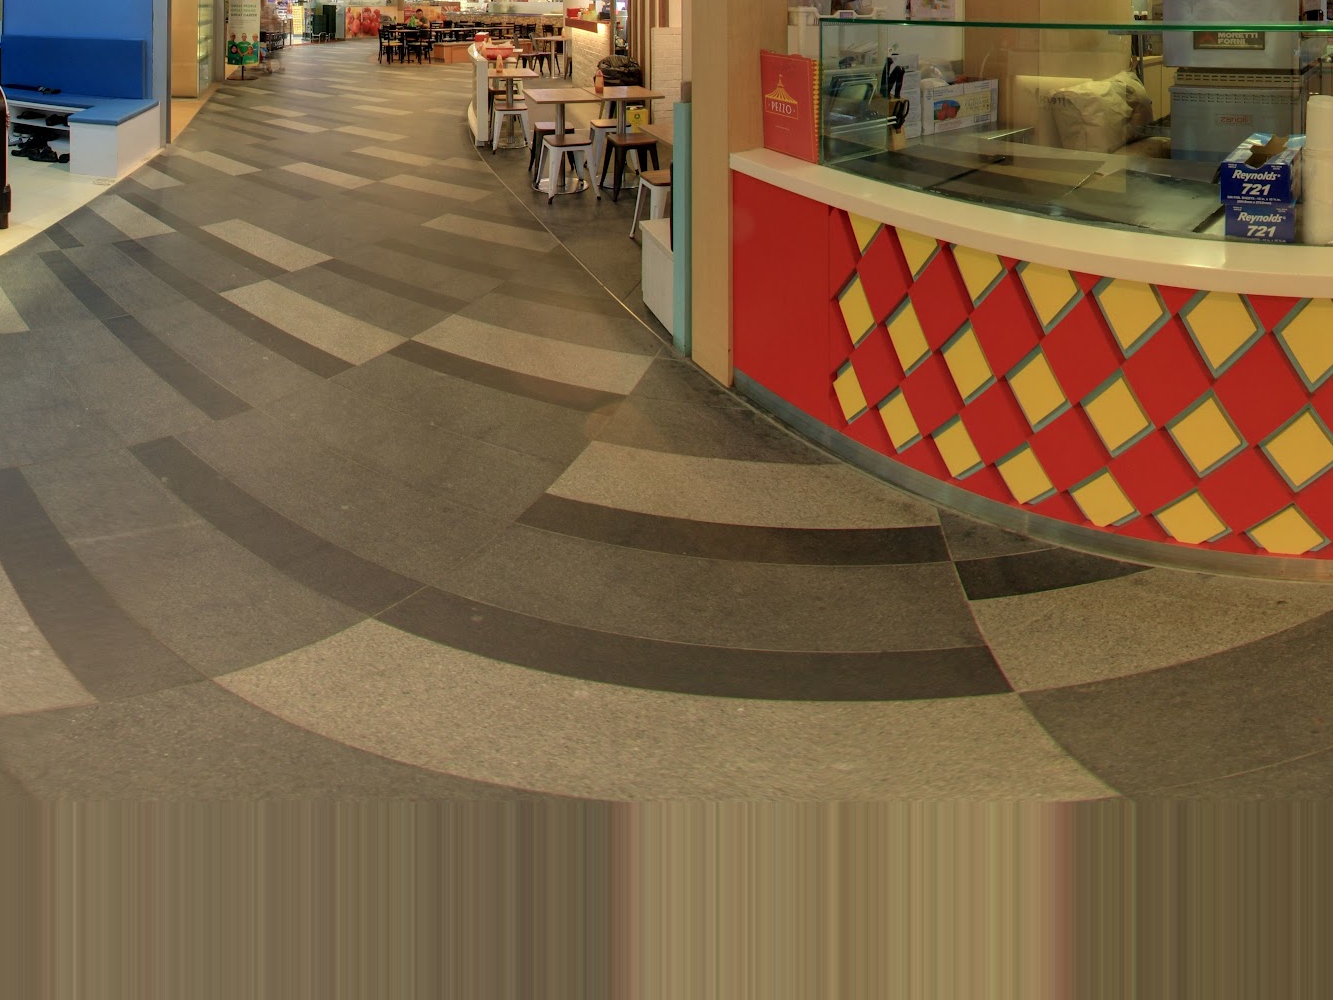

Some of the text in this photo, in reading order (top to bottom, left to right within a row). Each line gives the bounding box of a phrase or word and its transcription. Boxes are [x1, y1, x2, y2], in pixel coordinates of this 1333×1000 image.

[771, 101, 792, 114] PEZZO
[1241, 183, 1271, 195] 721
[1247, 225, 1276, 237] 721
